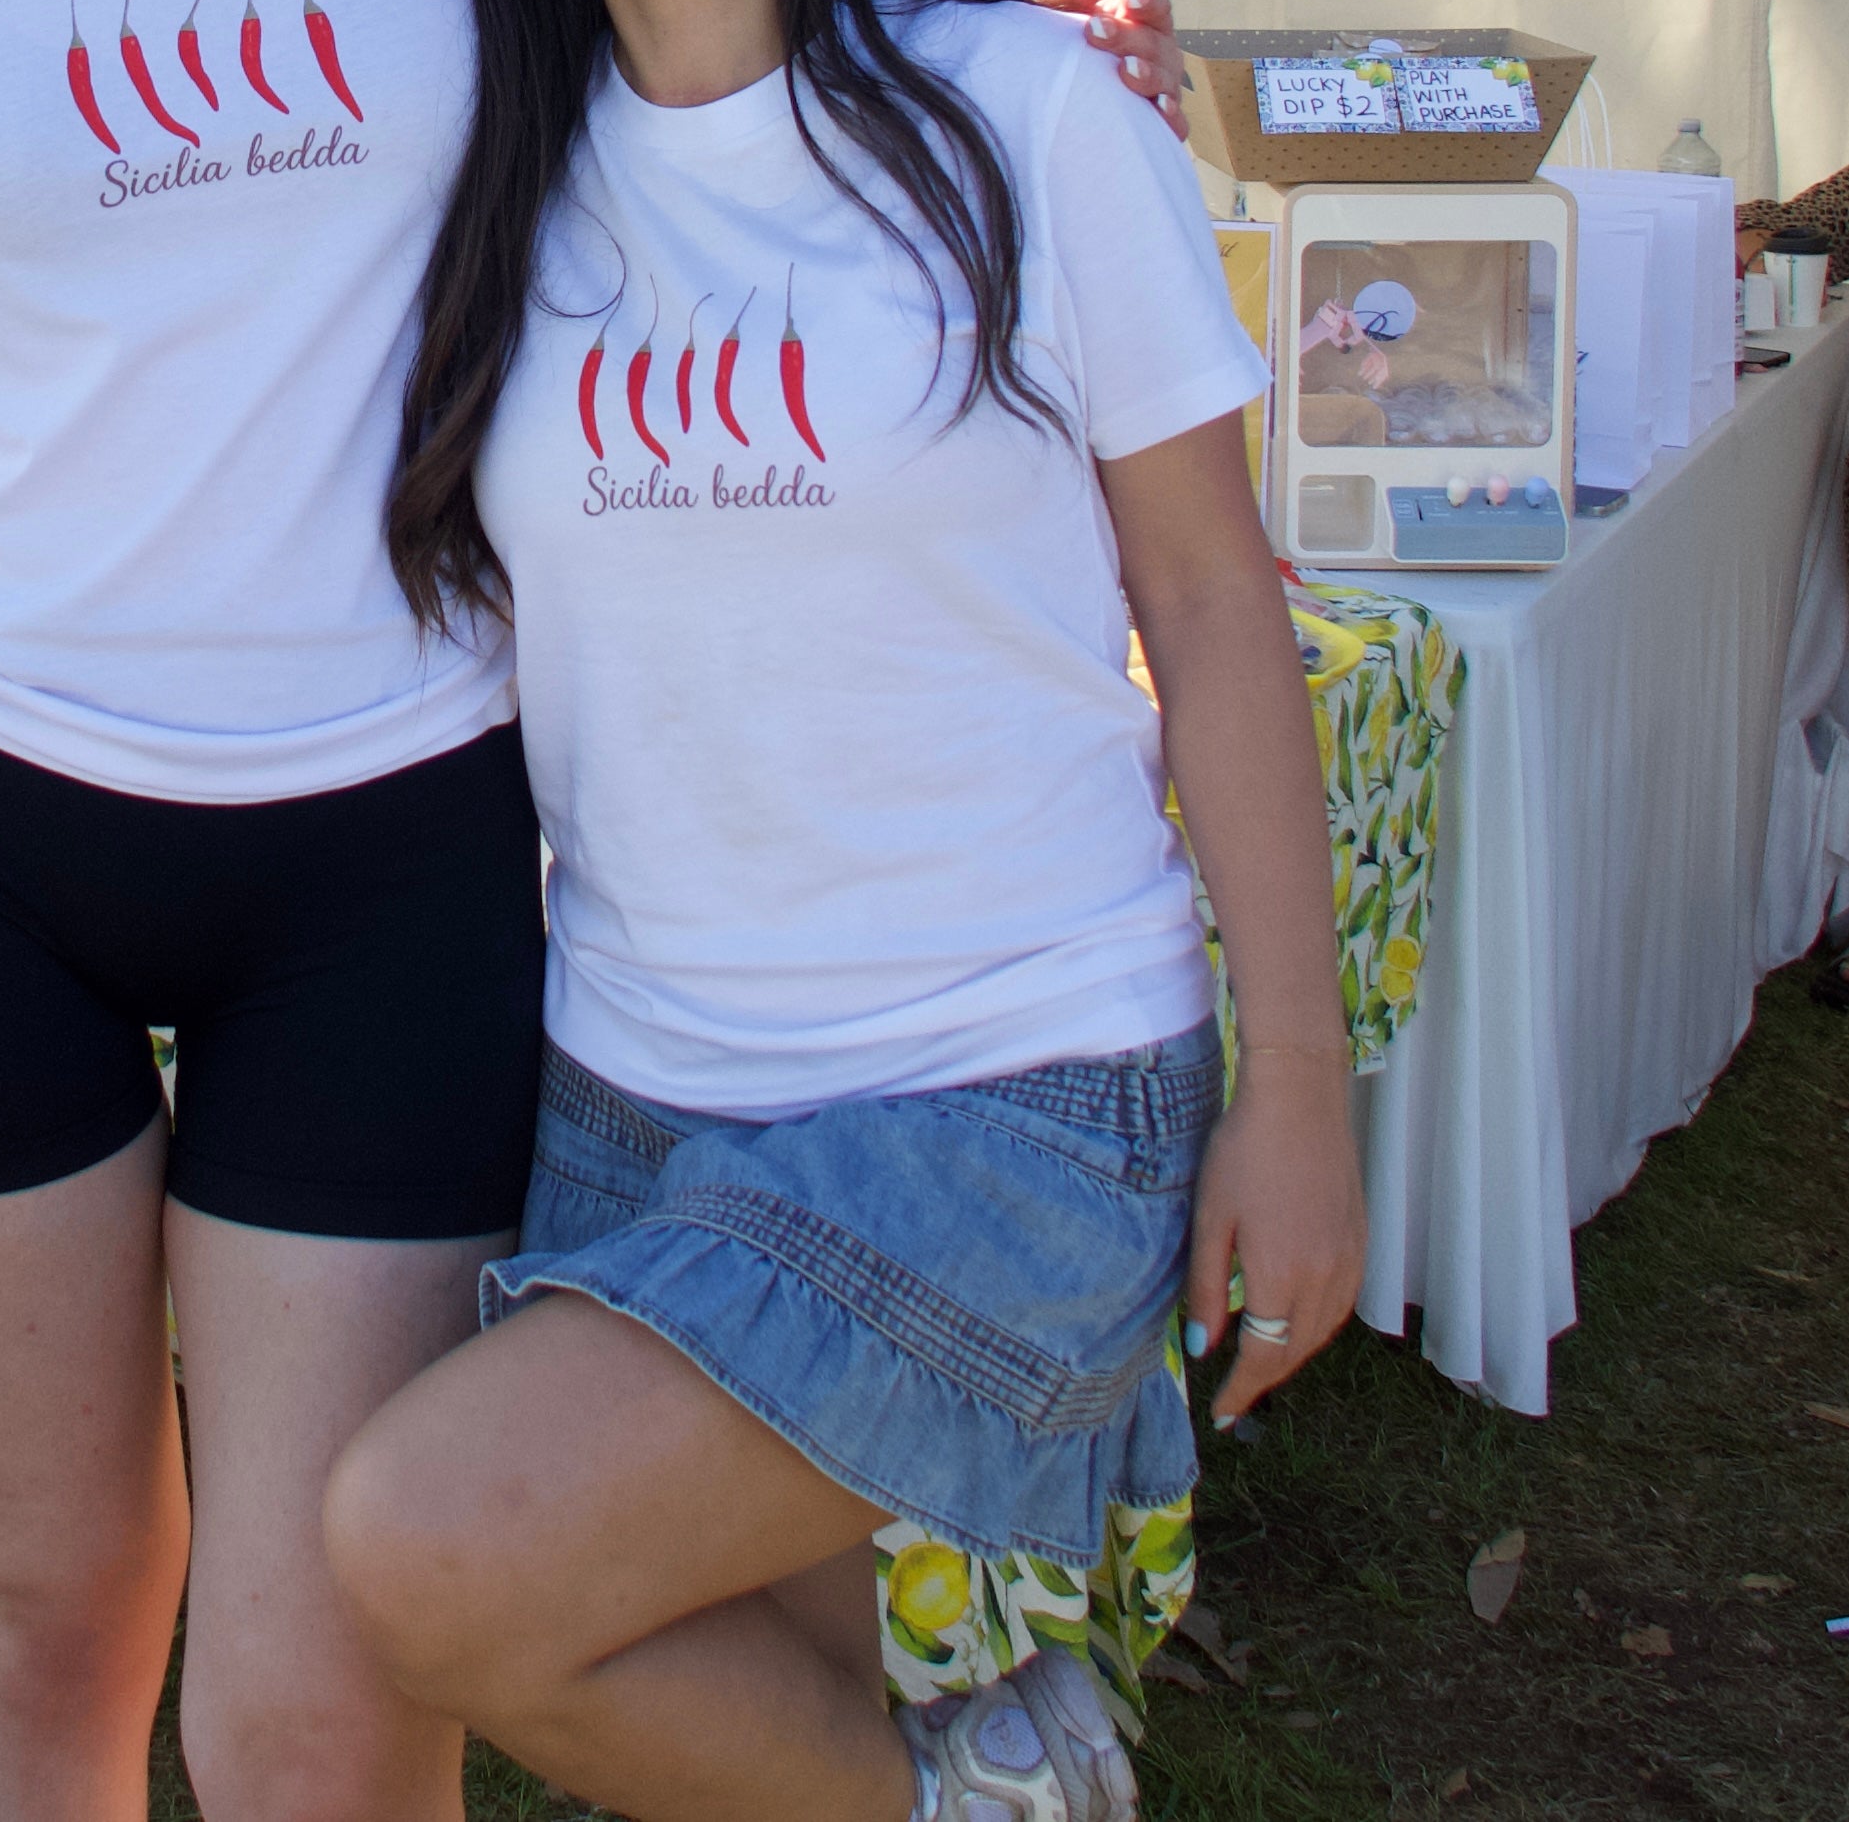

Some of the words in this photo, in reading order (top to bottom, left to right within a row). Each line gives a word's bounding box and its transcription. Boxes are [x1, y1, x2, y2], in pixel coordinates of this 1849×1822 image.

[1277, 77, 1345, 93] LUCKY
[1409, 70, 1450, 86] PLAY
[1413, 88, 1469, 104] WITH
[1283, 97, 1324, 115] DIP
[1337, 95, 1377, 117] $2
[1420, 104, 1517, 123] PURCHASE
[99, 146, 232, 208] Sicilia
[247, 125, 370, 176] bedda
[583, 464, 699, 516] Sicilia
[712, 463, 835, 509] bedda
